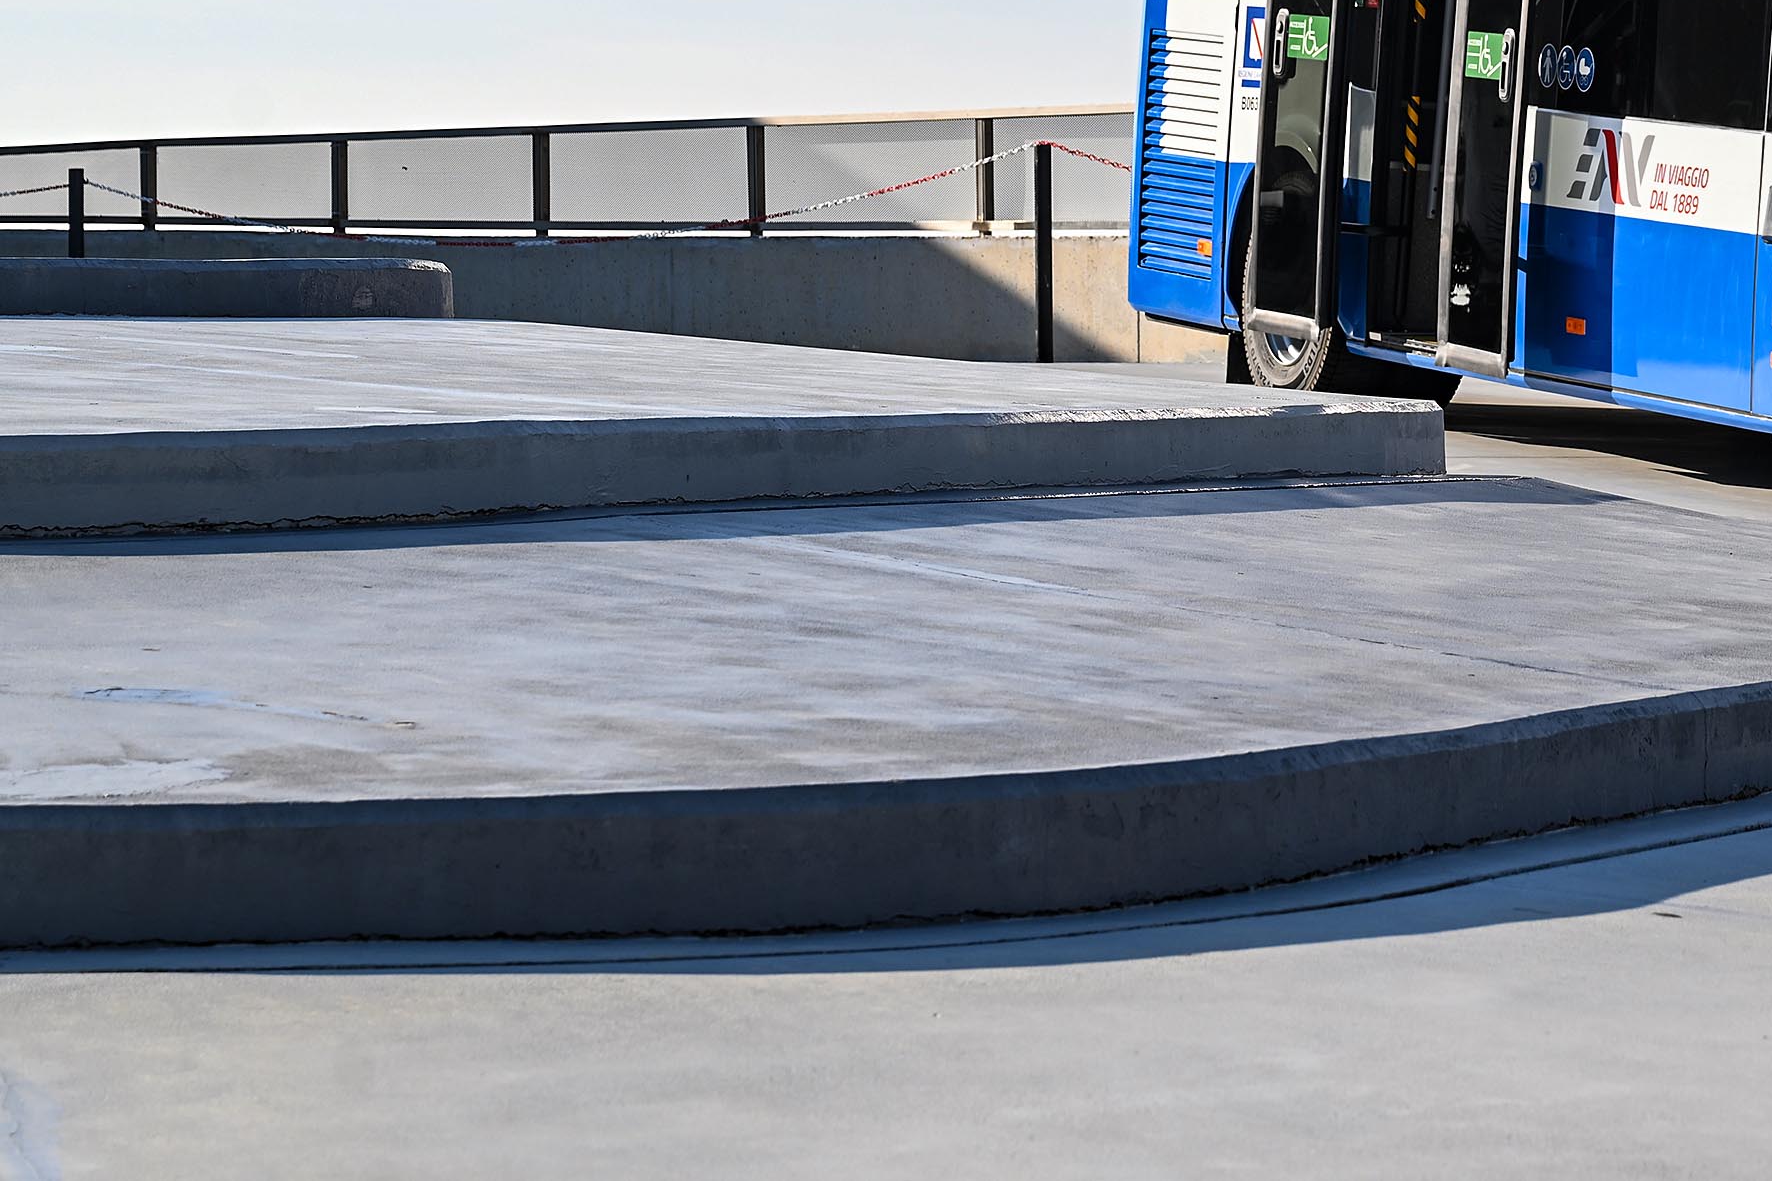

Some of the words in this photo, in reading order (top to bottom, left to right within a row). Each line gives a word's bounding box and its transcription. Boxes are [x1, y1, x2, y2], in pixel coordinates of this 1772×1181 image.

[1654, 163, 1667, 184] IN
[1668, 164, 1710, 189] VIAGGIO
[1650, 190, 1669, 211] DAL
[1672, 193, 1700, 215] 1889
